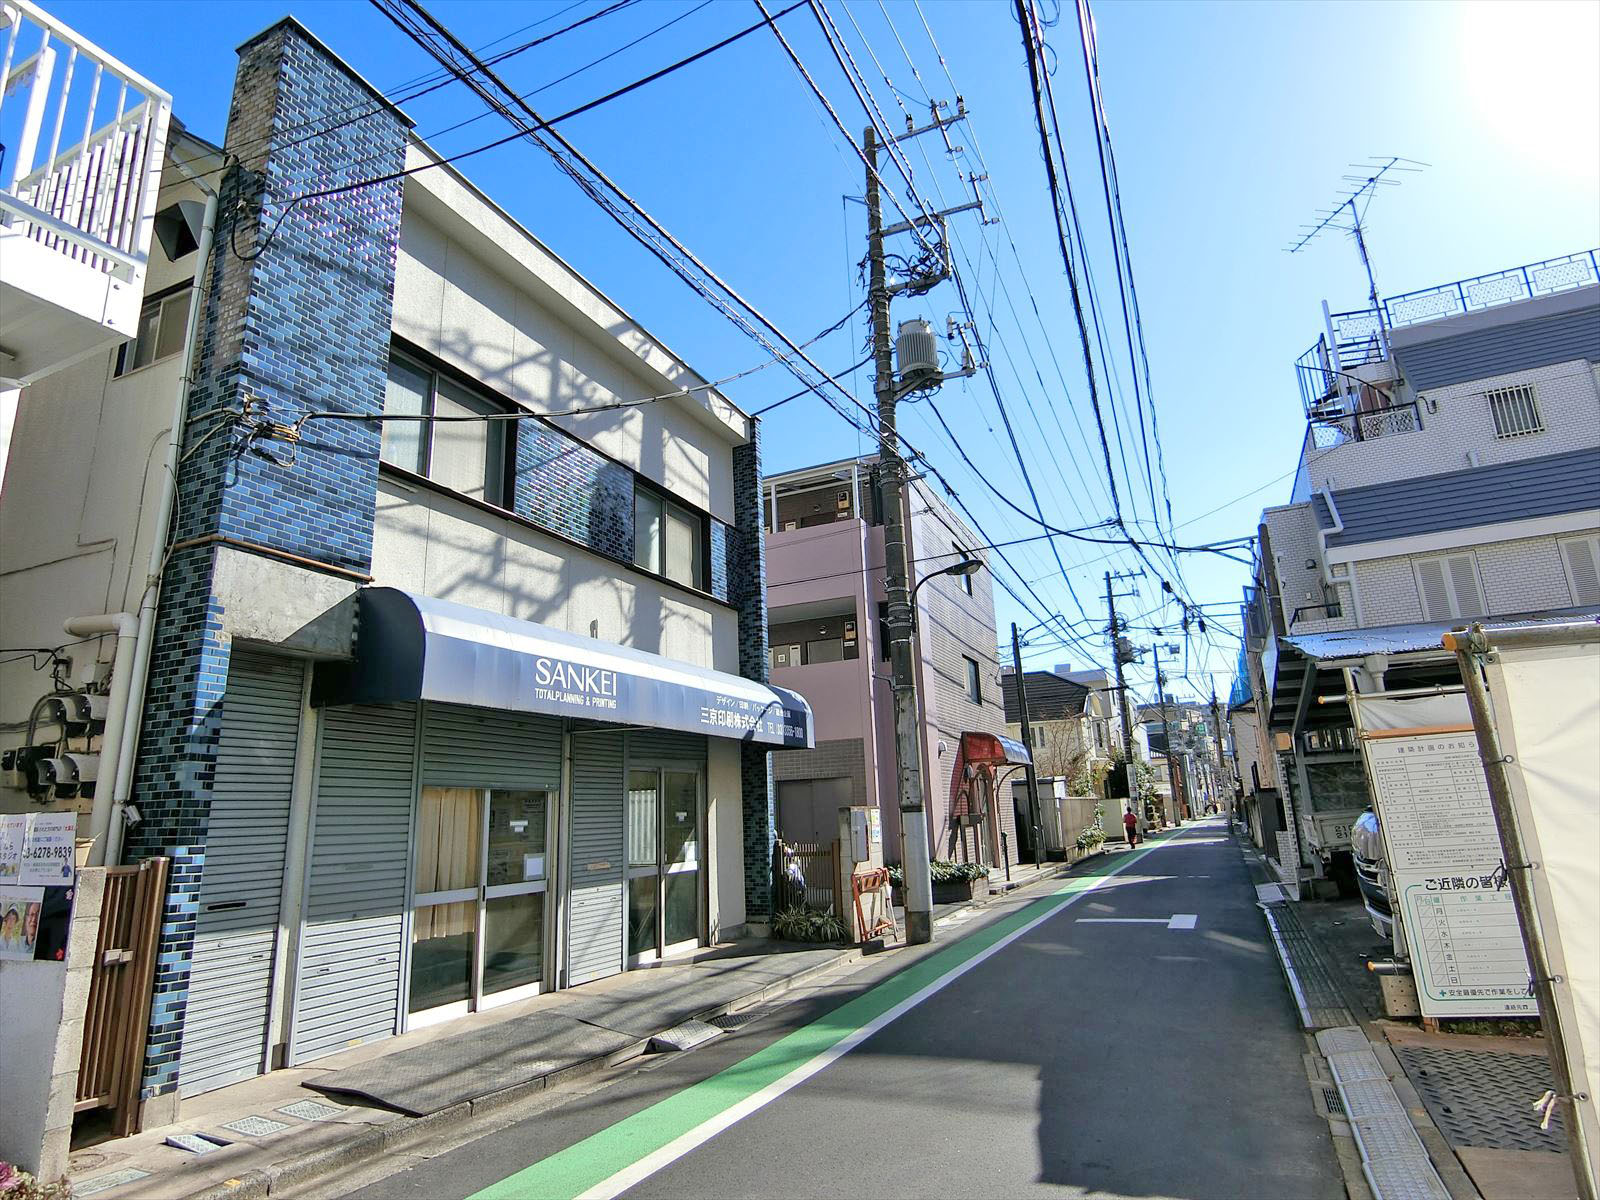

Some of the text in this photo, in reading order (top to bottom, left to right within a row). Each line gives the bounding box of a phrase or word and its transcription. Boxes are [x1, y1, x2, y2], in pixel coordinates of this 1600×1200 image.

[535, 658, 617, 696] SANKEI
[586, 697, 591, 706] &
[592, 697, 617, 709] PRINTING
[700, 706, 764, 732] 三京印刷株式会社
